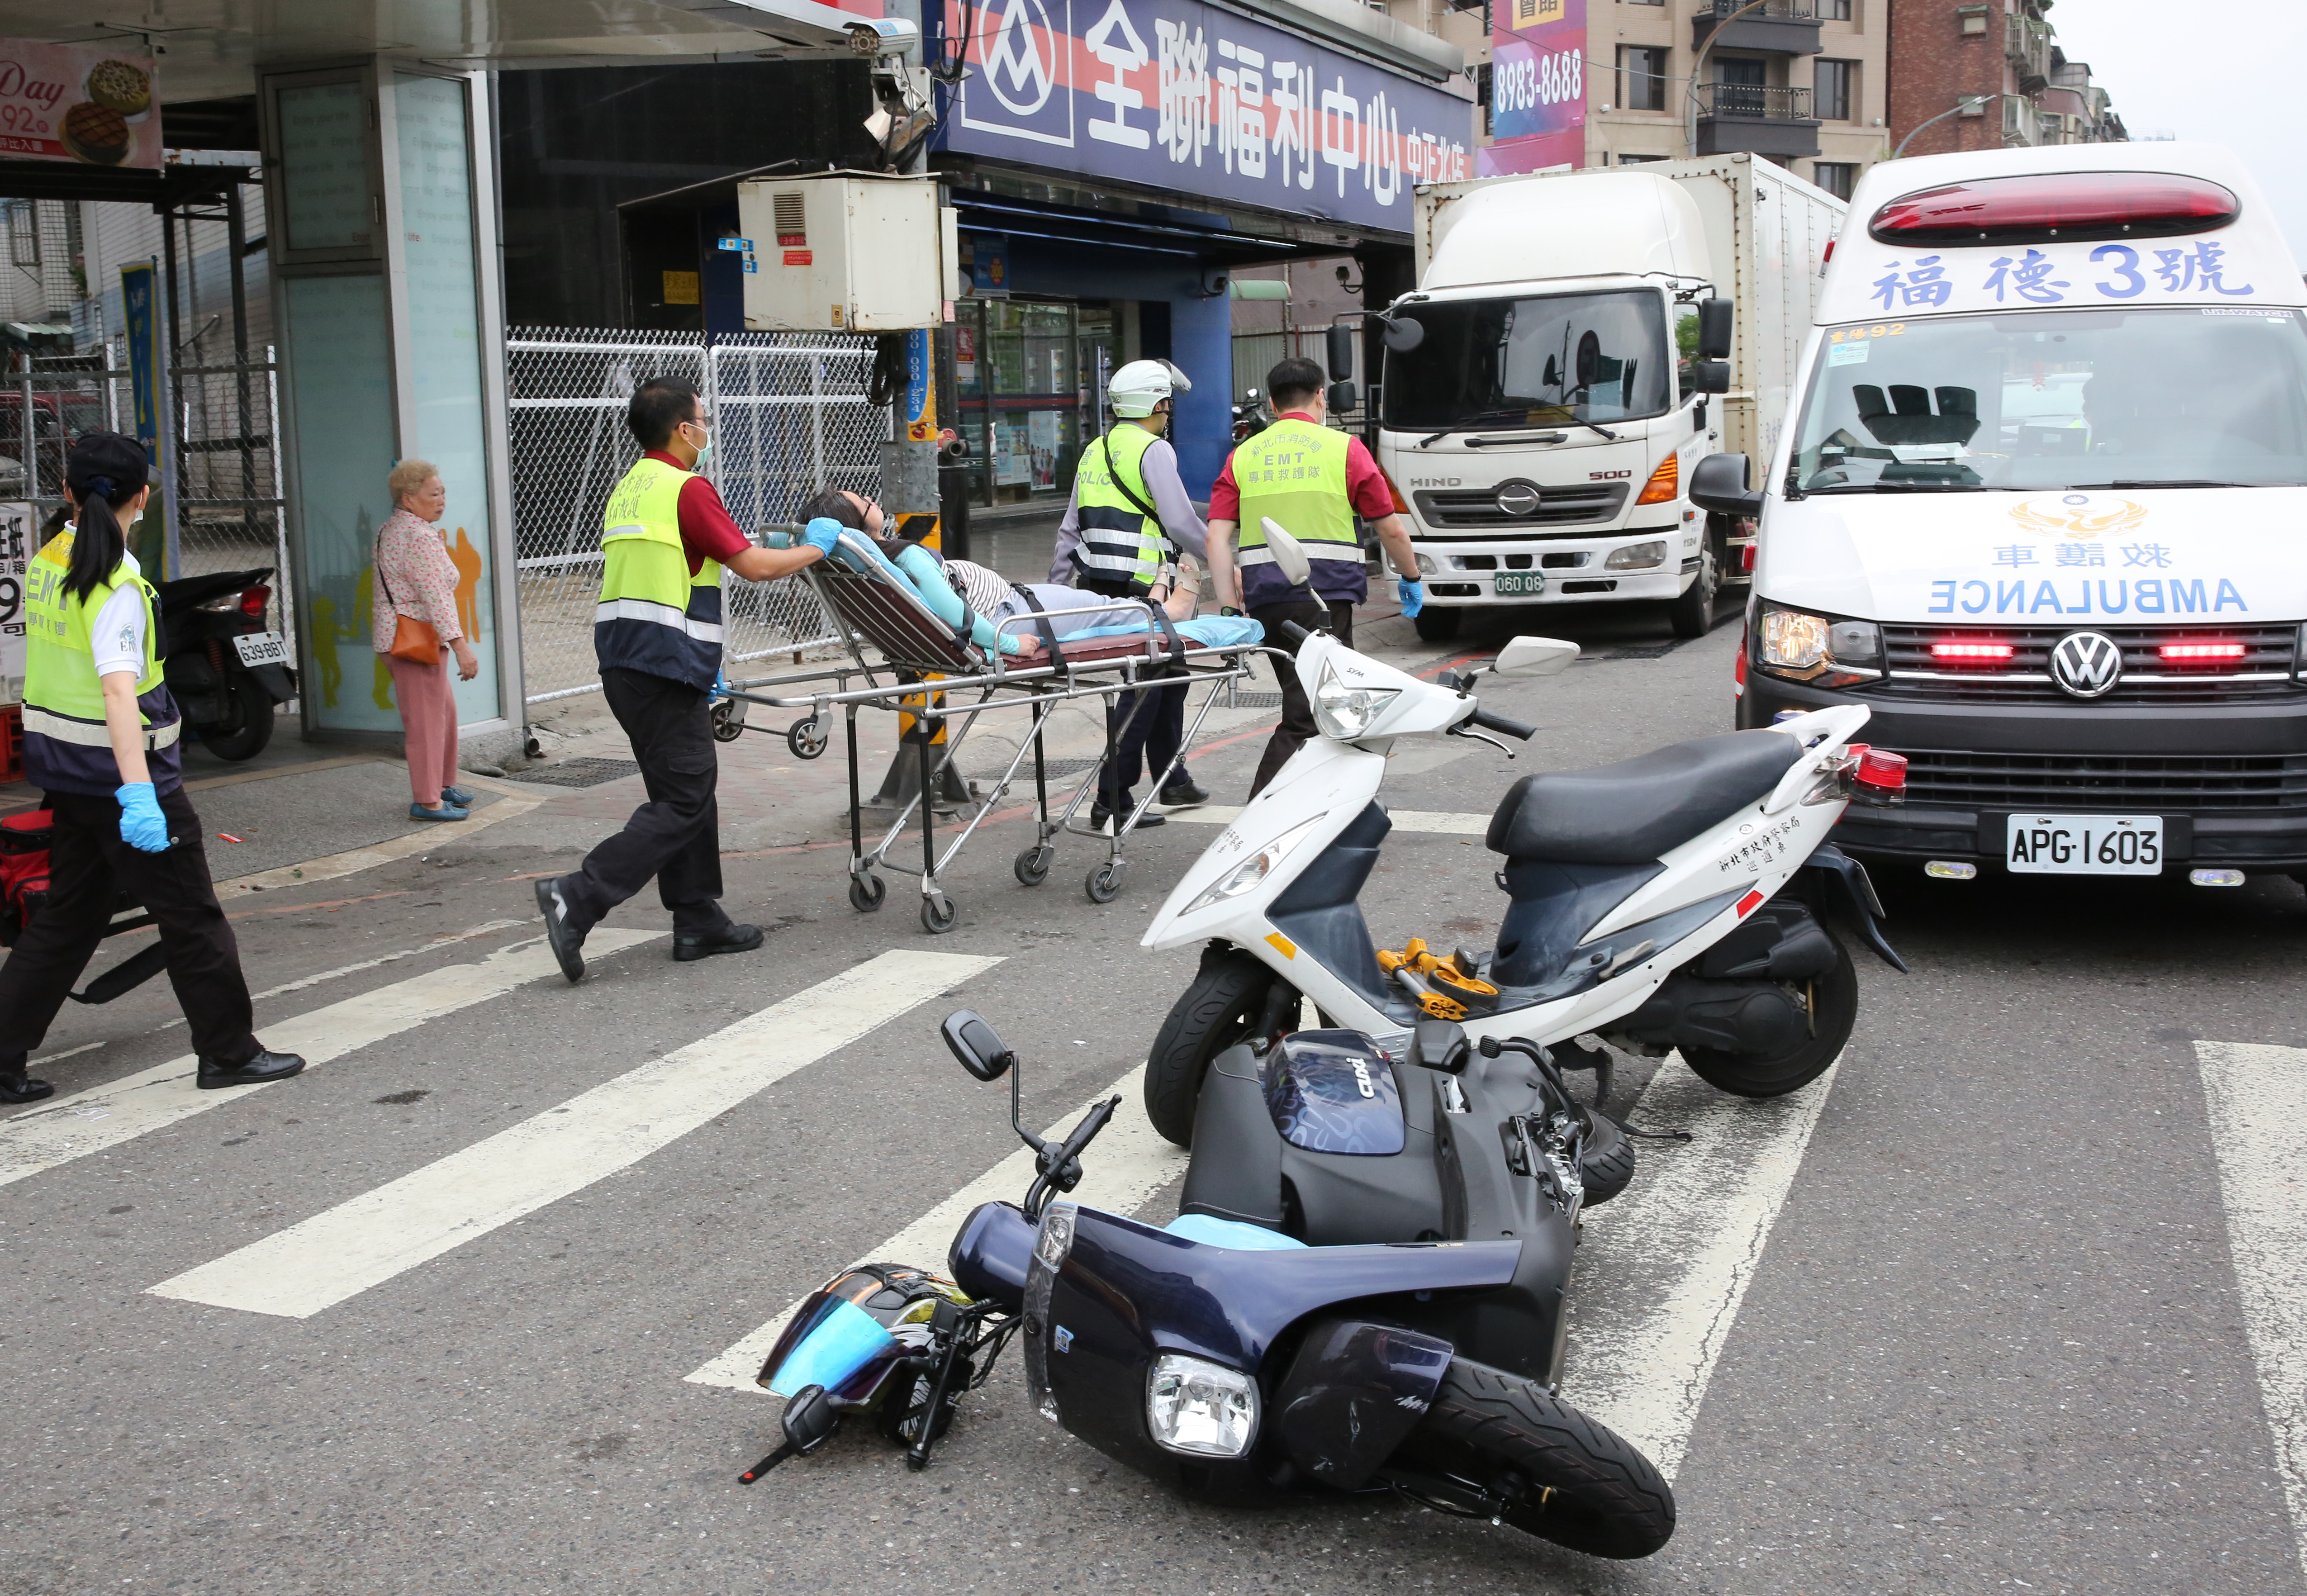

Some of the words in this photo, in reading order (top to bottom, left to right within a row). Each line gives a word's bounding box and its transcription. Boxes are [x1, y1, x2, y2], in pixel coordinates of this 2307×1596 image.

[0, 60, 65, 111] Day
[1497, 48, 1582, 113] 8983-8688
[1086, 0, 1401, 207] 全聯福利中心
[1407, 127, 1464, 185] 中正北店
[1870, 241, 2255, 311] 福德3號
[2203, 309, 2293, 317] LifeWATCH
[1829, 323, 1905, 343] 重陽92
[1251, 433, 1322, 458] 新北市消防局
[1264, 452, 1305, 466] EMT
[1248, 466, 1320, 484] 專責救護隊
[1410, 477, 1462, 487] HINO
[1589, 469, 1631, 480] 500
[240, 641, 286, 661] 639-BBT
[1346, 667, 1365, 678] SYM
[1718, 816, 1800, 873] 新北市政府警察局
[2012, 829, 2158, 864] APG-1603
